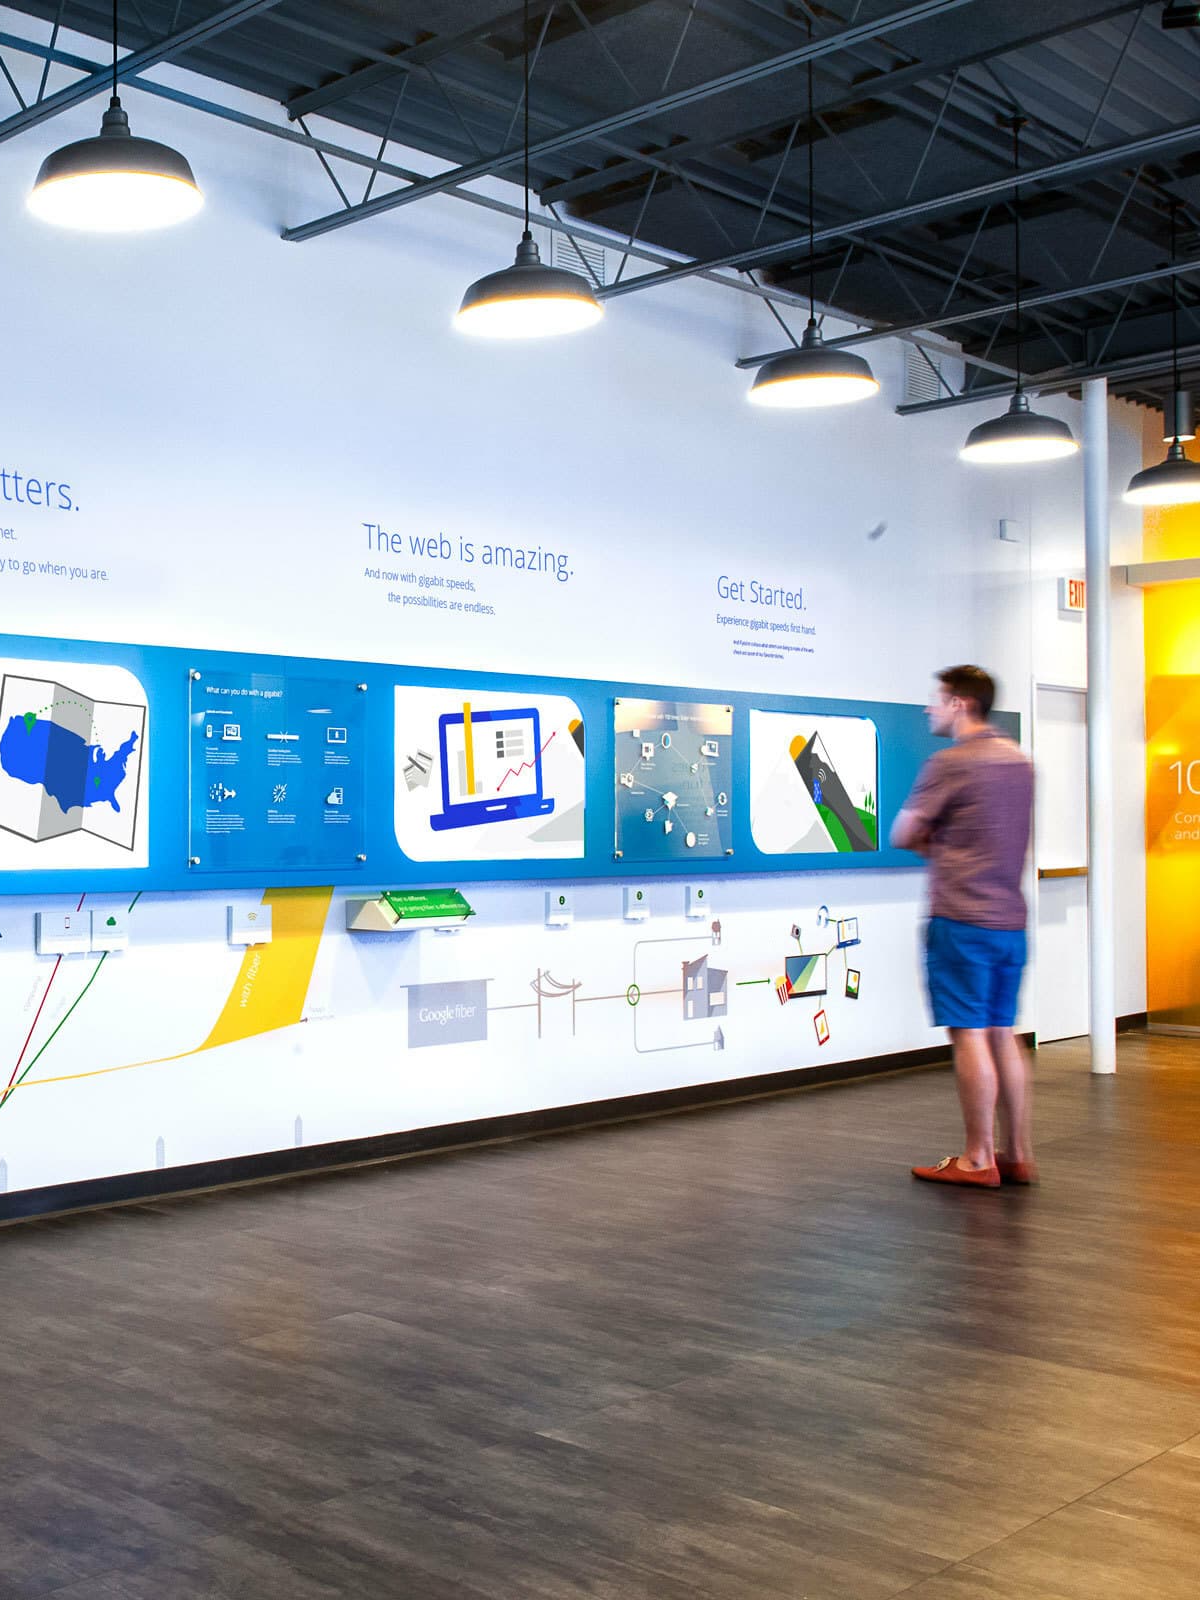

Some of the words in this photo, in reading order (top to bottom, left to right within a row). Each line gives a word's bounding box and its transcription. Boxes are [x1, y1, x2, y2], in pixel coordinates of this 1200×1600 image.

[361, 523, 402, 553] The
[409, 532, 451, 560] web
[459, 536, 475, 563] is
[482, 544, 574, 582] amazing.
[8, 557, 20, 571] to
[22, 561, 36, 575] go
[38, 561, 67, 577] when
[69, 567, 88, 580] you
[364, 567, 380, 580] And
[382, 571, 399, 582] now
[400, 571, 417, 584] with
[418, 573, 444, 588] gigabit
[446, 578, 476, 592] speeds,
[388, 591, 401, 604] the
[402, 594, 447, 609] possibilities
[449, 601, 462, 611] are
[464, 602, 496, 615] endless.
[717, 575, 745, 602] Get
[750, 580, 807, 611] Started.
[1069, 580, 1085, 608] EXIT
[246, 951, 261, 981] fiber
[419, 1004, 454, 1025] Google
[455, 1003, 476, 1018] fiber
